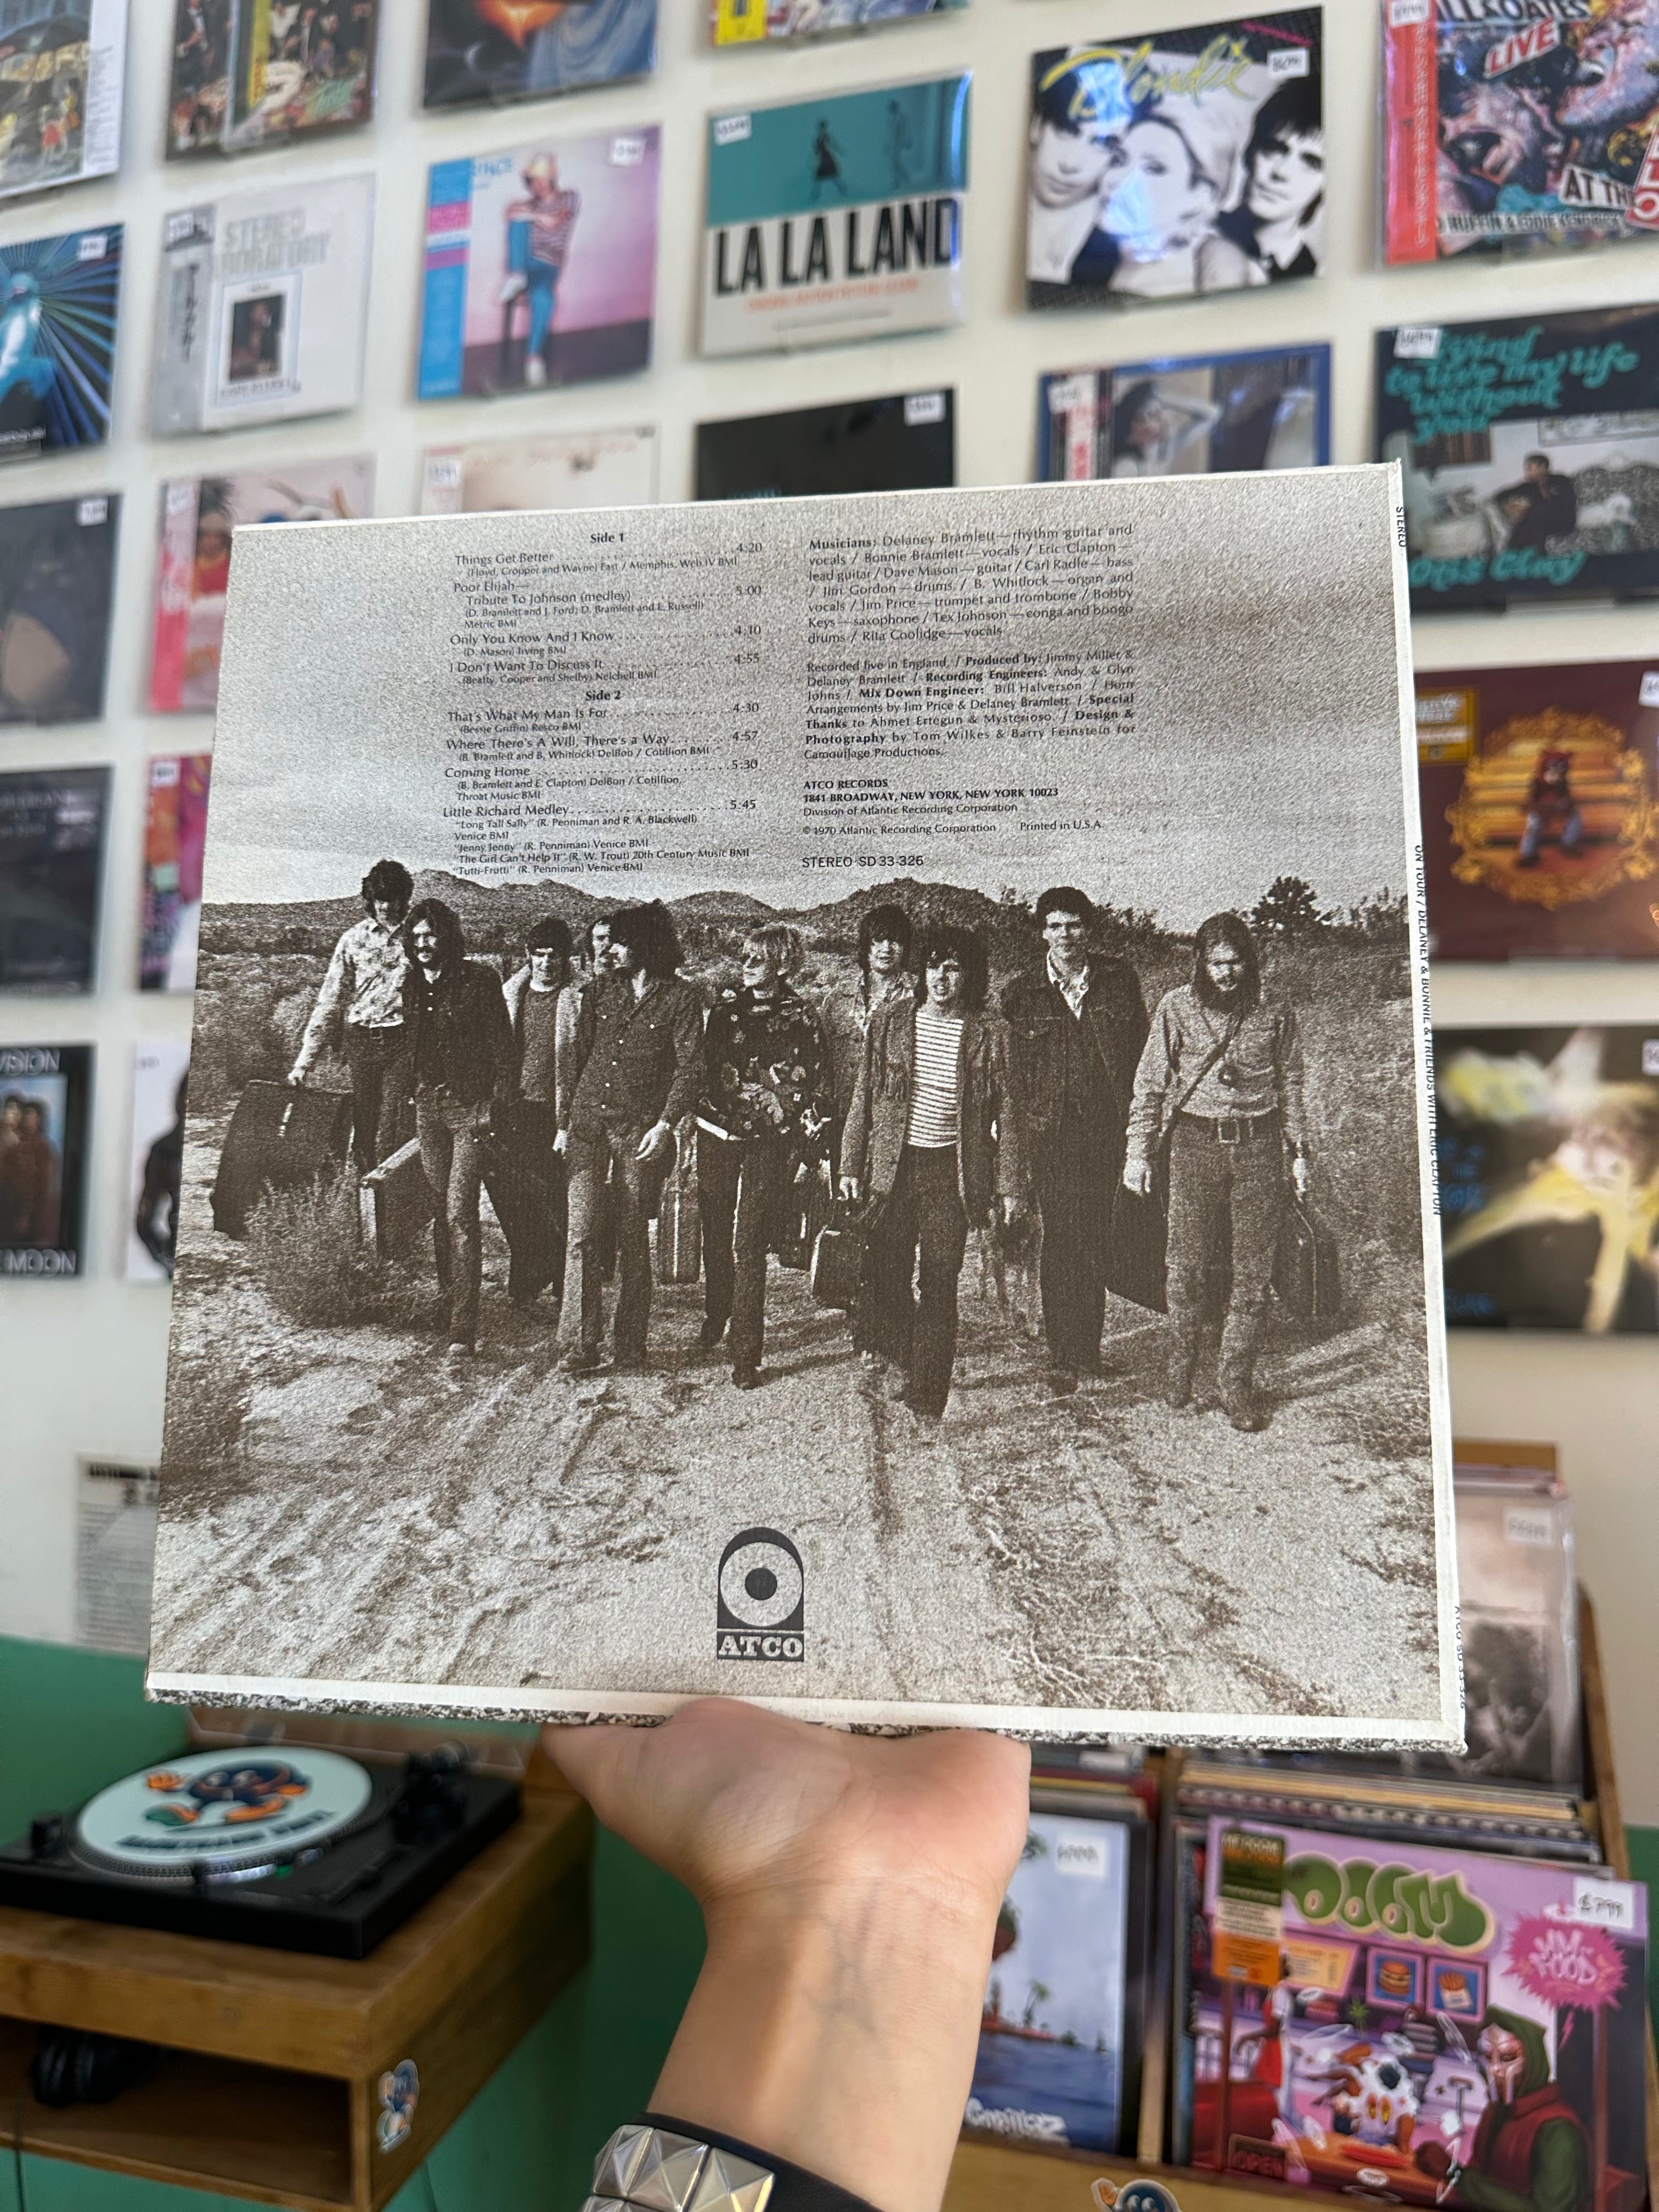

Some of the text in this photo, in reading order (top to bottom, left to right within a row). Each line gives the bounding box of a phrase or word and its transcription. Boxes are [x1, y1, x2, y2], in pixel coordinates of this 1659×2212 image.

[1491, 17, 1555, 72] LIVE
[1565, 168, 1593, 202] AT
[716, 225, 766, 297] LA
[780, 213, 830, 287] LA
[845, 196, 961, 278] LAND
[1396, 506, 1407, 548] STEREO
[590, 532, 624, 544] Side 1
[455, 555, 492, 567] Things
[495, 553, 516, 565] Get
[519, 552, 554, 563] Better
[454, 582, 481, 593] Poor
[466, 595, 508, 606] Tribute
[512, 594, 526, 605] To
[530, 592, 576, 605] Johnson
[580, 590, 631, 603] (medley)
[450, 633, 479, 646] Only
[482, 634, 505, 644] You
[509, 633, 542, 644] Know
[546, 631, 569, 642] And
[582, 631, 614, 642] Know
[735, 625, 761, 636] 4:10
[458, 661, 491, 673] Don't
[494, 661, 526, 672] Want
[529, 660, 544, 670] To
[548, 659, 591, 670] Discuss
[595, 659, 604, 669] It
[734, 653, 760, 665] 4:55
[585, 690, 621, 702] Side 2
[448, 702, 760, 722] That's What My Man Is For 4:30
[805, 719, 847, 730] Thanks
[853, 718, 865, 727] to
[870, 716, 910, 727] Ahmet
[916, 715, 963, 727] Ertegun
[969, 714, 978, 724] &
[1074, 709, 1119, 721] Design
[1124, 709, 1135, 719] &
[446, 739, 486, 750] Where
[492, 737, 533, 749] There's
[537, 737, 546, 748] A
[551, 736, 579, 748] Will,
[584, 735, 626, 746] There's
[642, 733, 669, 746] Way
[732, 730, 759, 742] 4:57
[805, 723, 1137, 746] Photography by Tom Wilkes & Barry Feinstein for
[804, 746, 944, 760] Camouflage Productions.
[445, 759, 758, 780] Coming Home 5:30
[803, 778, 888, 790] ATCO RECORDS
[456, 791, 541, 802] Throat Music BMI
[803, 787, 1059, 803] 1841 BROADWAY, NEW YORK, NEW YORK 10023
[443, 799, 757, 817] Little Richard Medley 5:45
[803, 803, 1018, 817] Division of Atlantic Recording Corporation
[487, 819, 504, 829] Tall
[538, 818, 549, 828] (R.
[552, 817, 600, 827] Penniman
[602, 816, 620, 825] and
[623, 816, 632, 825] R.
[635, 815, 646, 825] A.
[648, 814, 698, 825] Blackwell)
[814, 826, 837, 835] 1970
[839, 825, 878, 835] Atlantic
[881, 824, 932, 835] Recording
[935, 823, 996, 833] Corporation
[1019, 820, 1057, 831] Printed
[1060, 821, 1070, 830] in
[454, 831, 509, 841] Venice BMI
[802, 855, 924, 868] STEREO SD 33-326
[1415, 845, 1423, 862] ON
[1418, 910, 1428, 961] DELANEY
[1421, 966, 1429, 974] &
[1421, 978, 1431, 1024] BONNIE
[1423, 1027, 1431, 1036] &
[718, 1635, 803, 1658] ATCO
